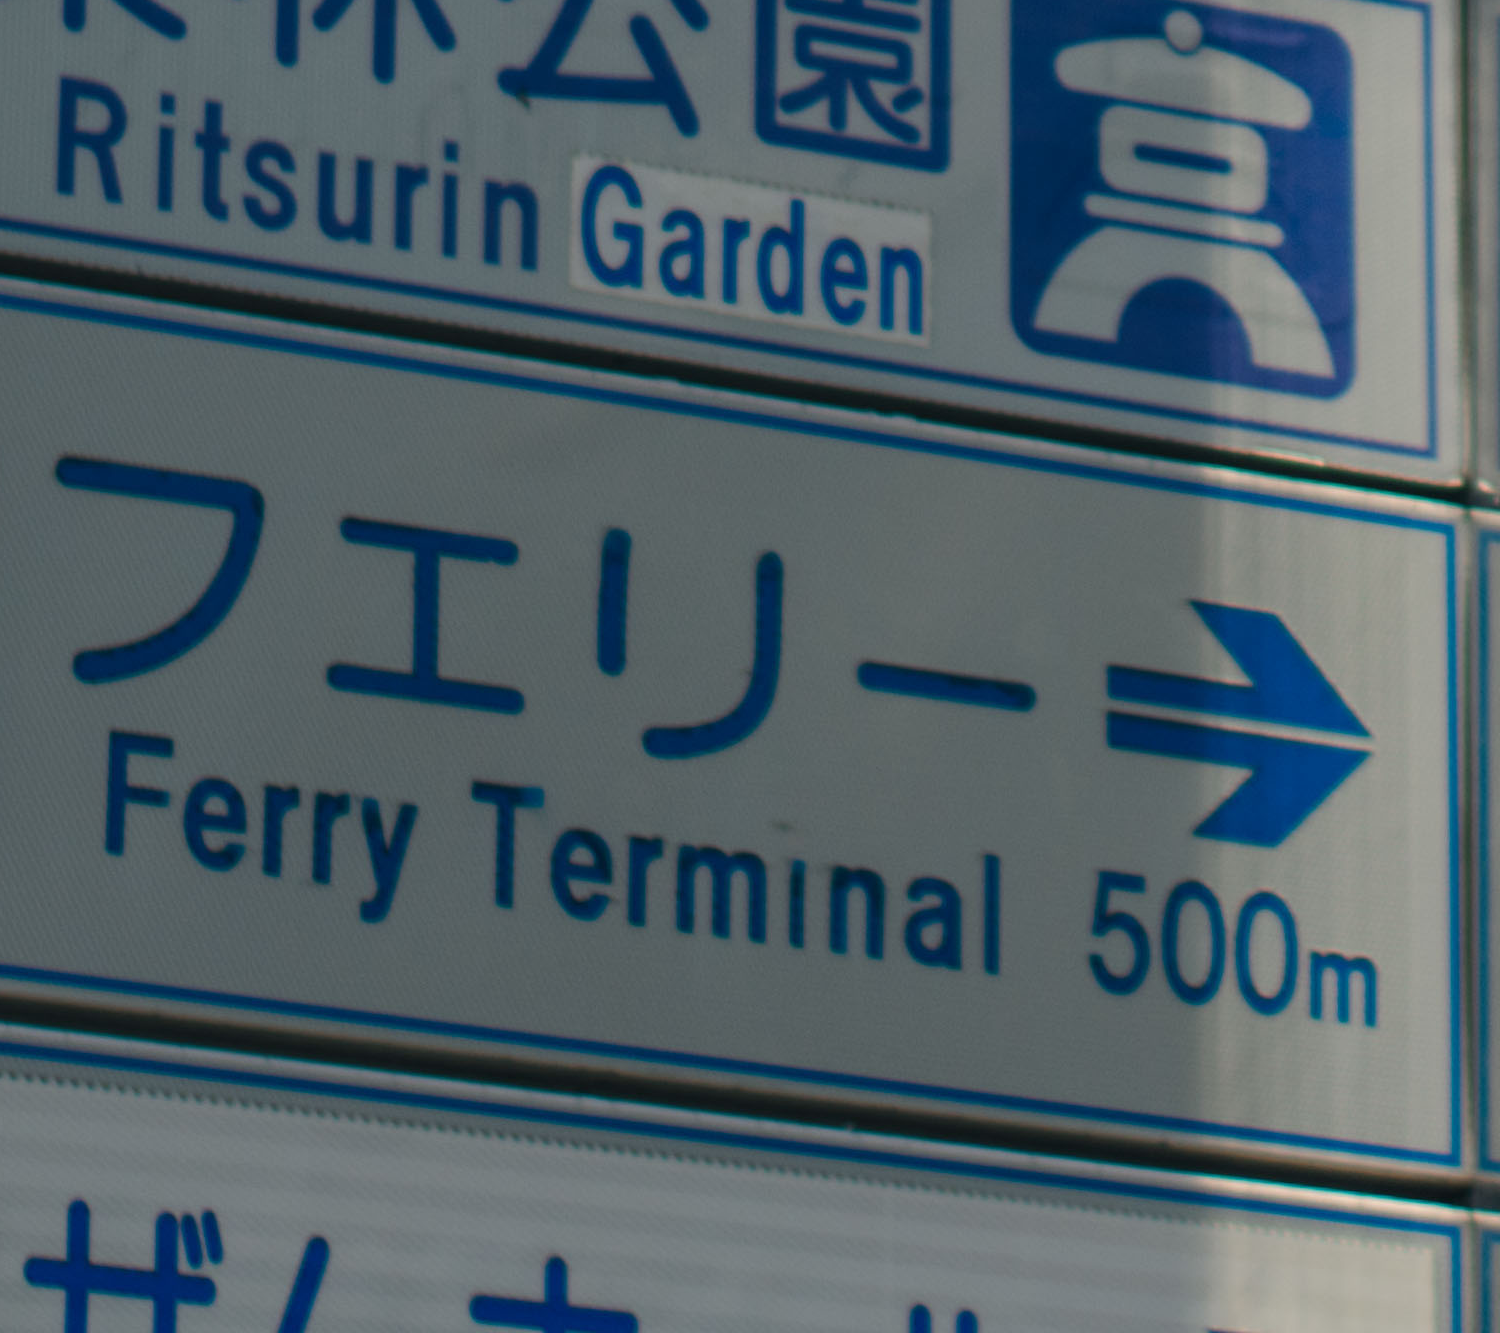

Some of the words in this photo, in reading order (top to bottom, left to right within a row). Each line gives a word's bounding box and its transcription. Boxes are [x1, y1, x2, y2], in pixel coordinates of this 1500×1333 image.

[56, 77, 538, 272] Ritsurin
[581, 165, 922, 335] Garden
[54, 457, 1037, 760] フェリー
[105, 731, 418, 924] Ferry
[471, 781, 1000, 976] Terminal
[1087, 870, 1376, 1027] 500m
